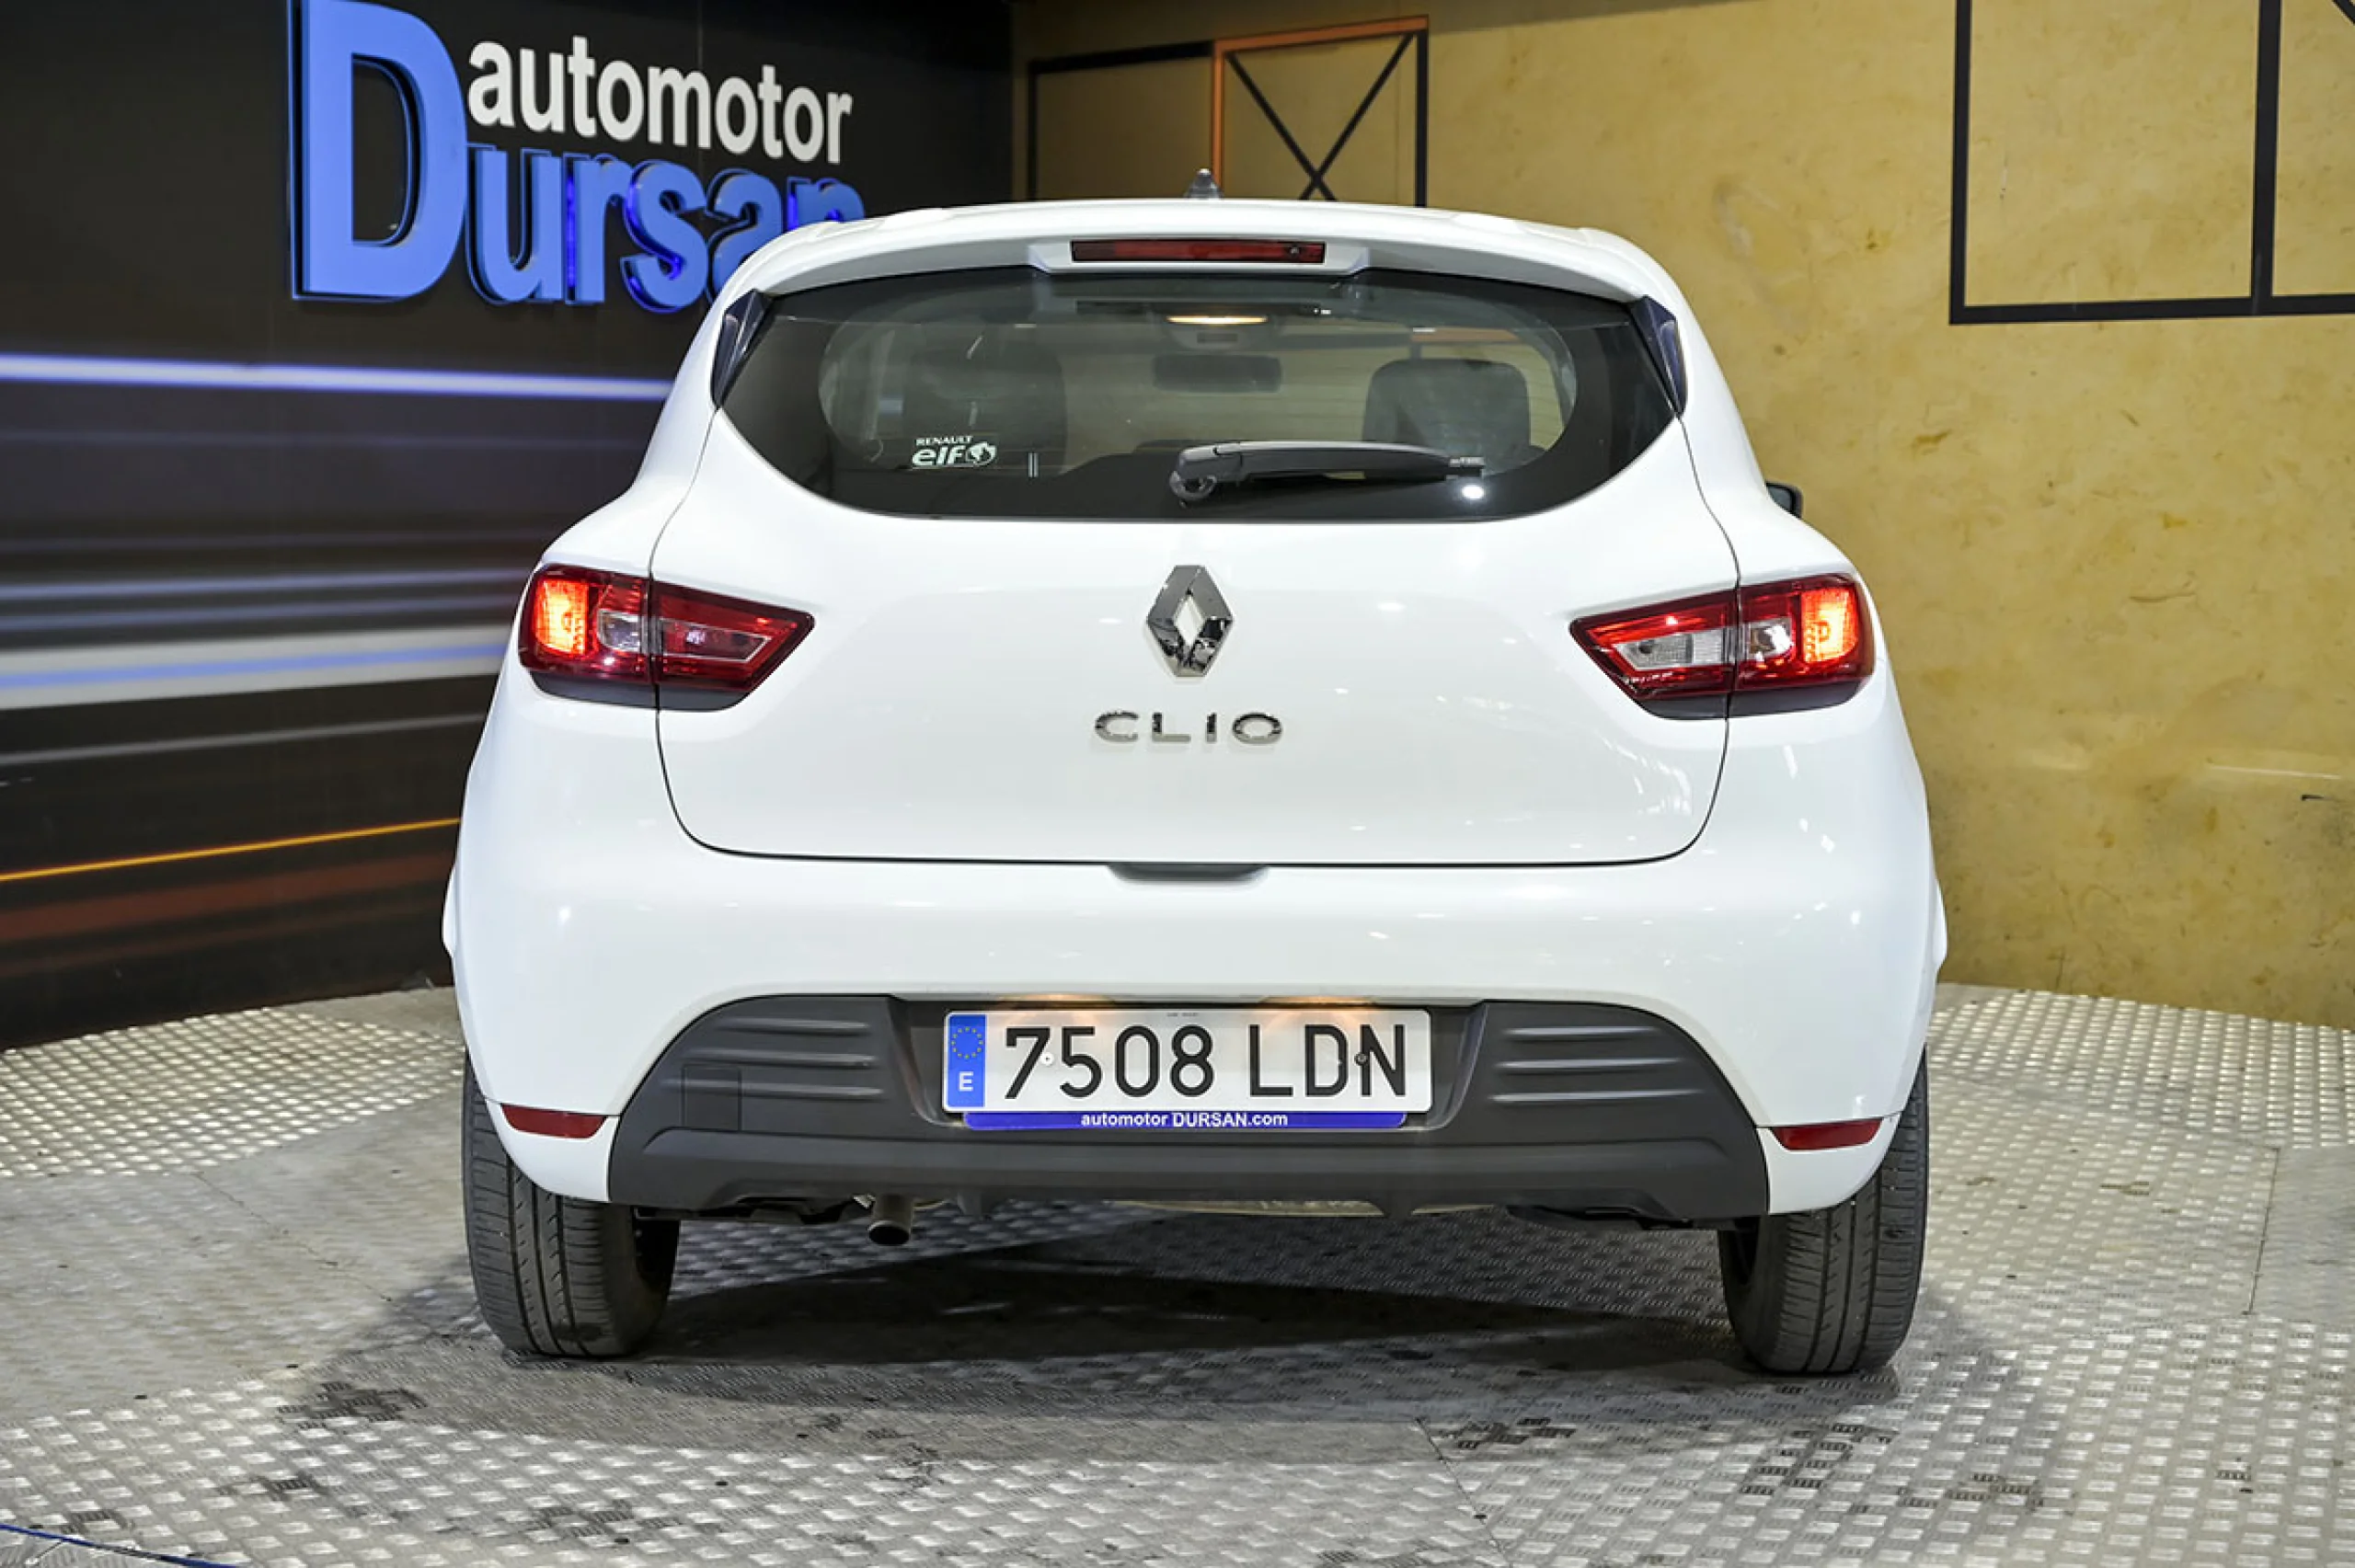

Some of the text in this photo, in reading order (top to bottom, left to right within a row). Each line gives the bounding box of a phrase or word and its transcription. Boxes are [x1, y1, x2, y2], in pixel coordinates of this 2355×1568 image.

[467, 35, 852, 164] automotor
[915, 435, 972, 445] RENAULT
[912, 445, 966, 466] elf
[1095, 710, 1282, 745] CLIO
[1004, 1024, 1407, 1100] 7508 LDN
[959, 1070, 974, 1092] E
[1081, 1112, 1288, 1127] automotor DURSAN.com
